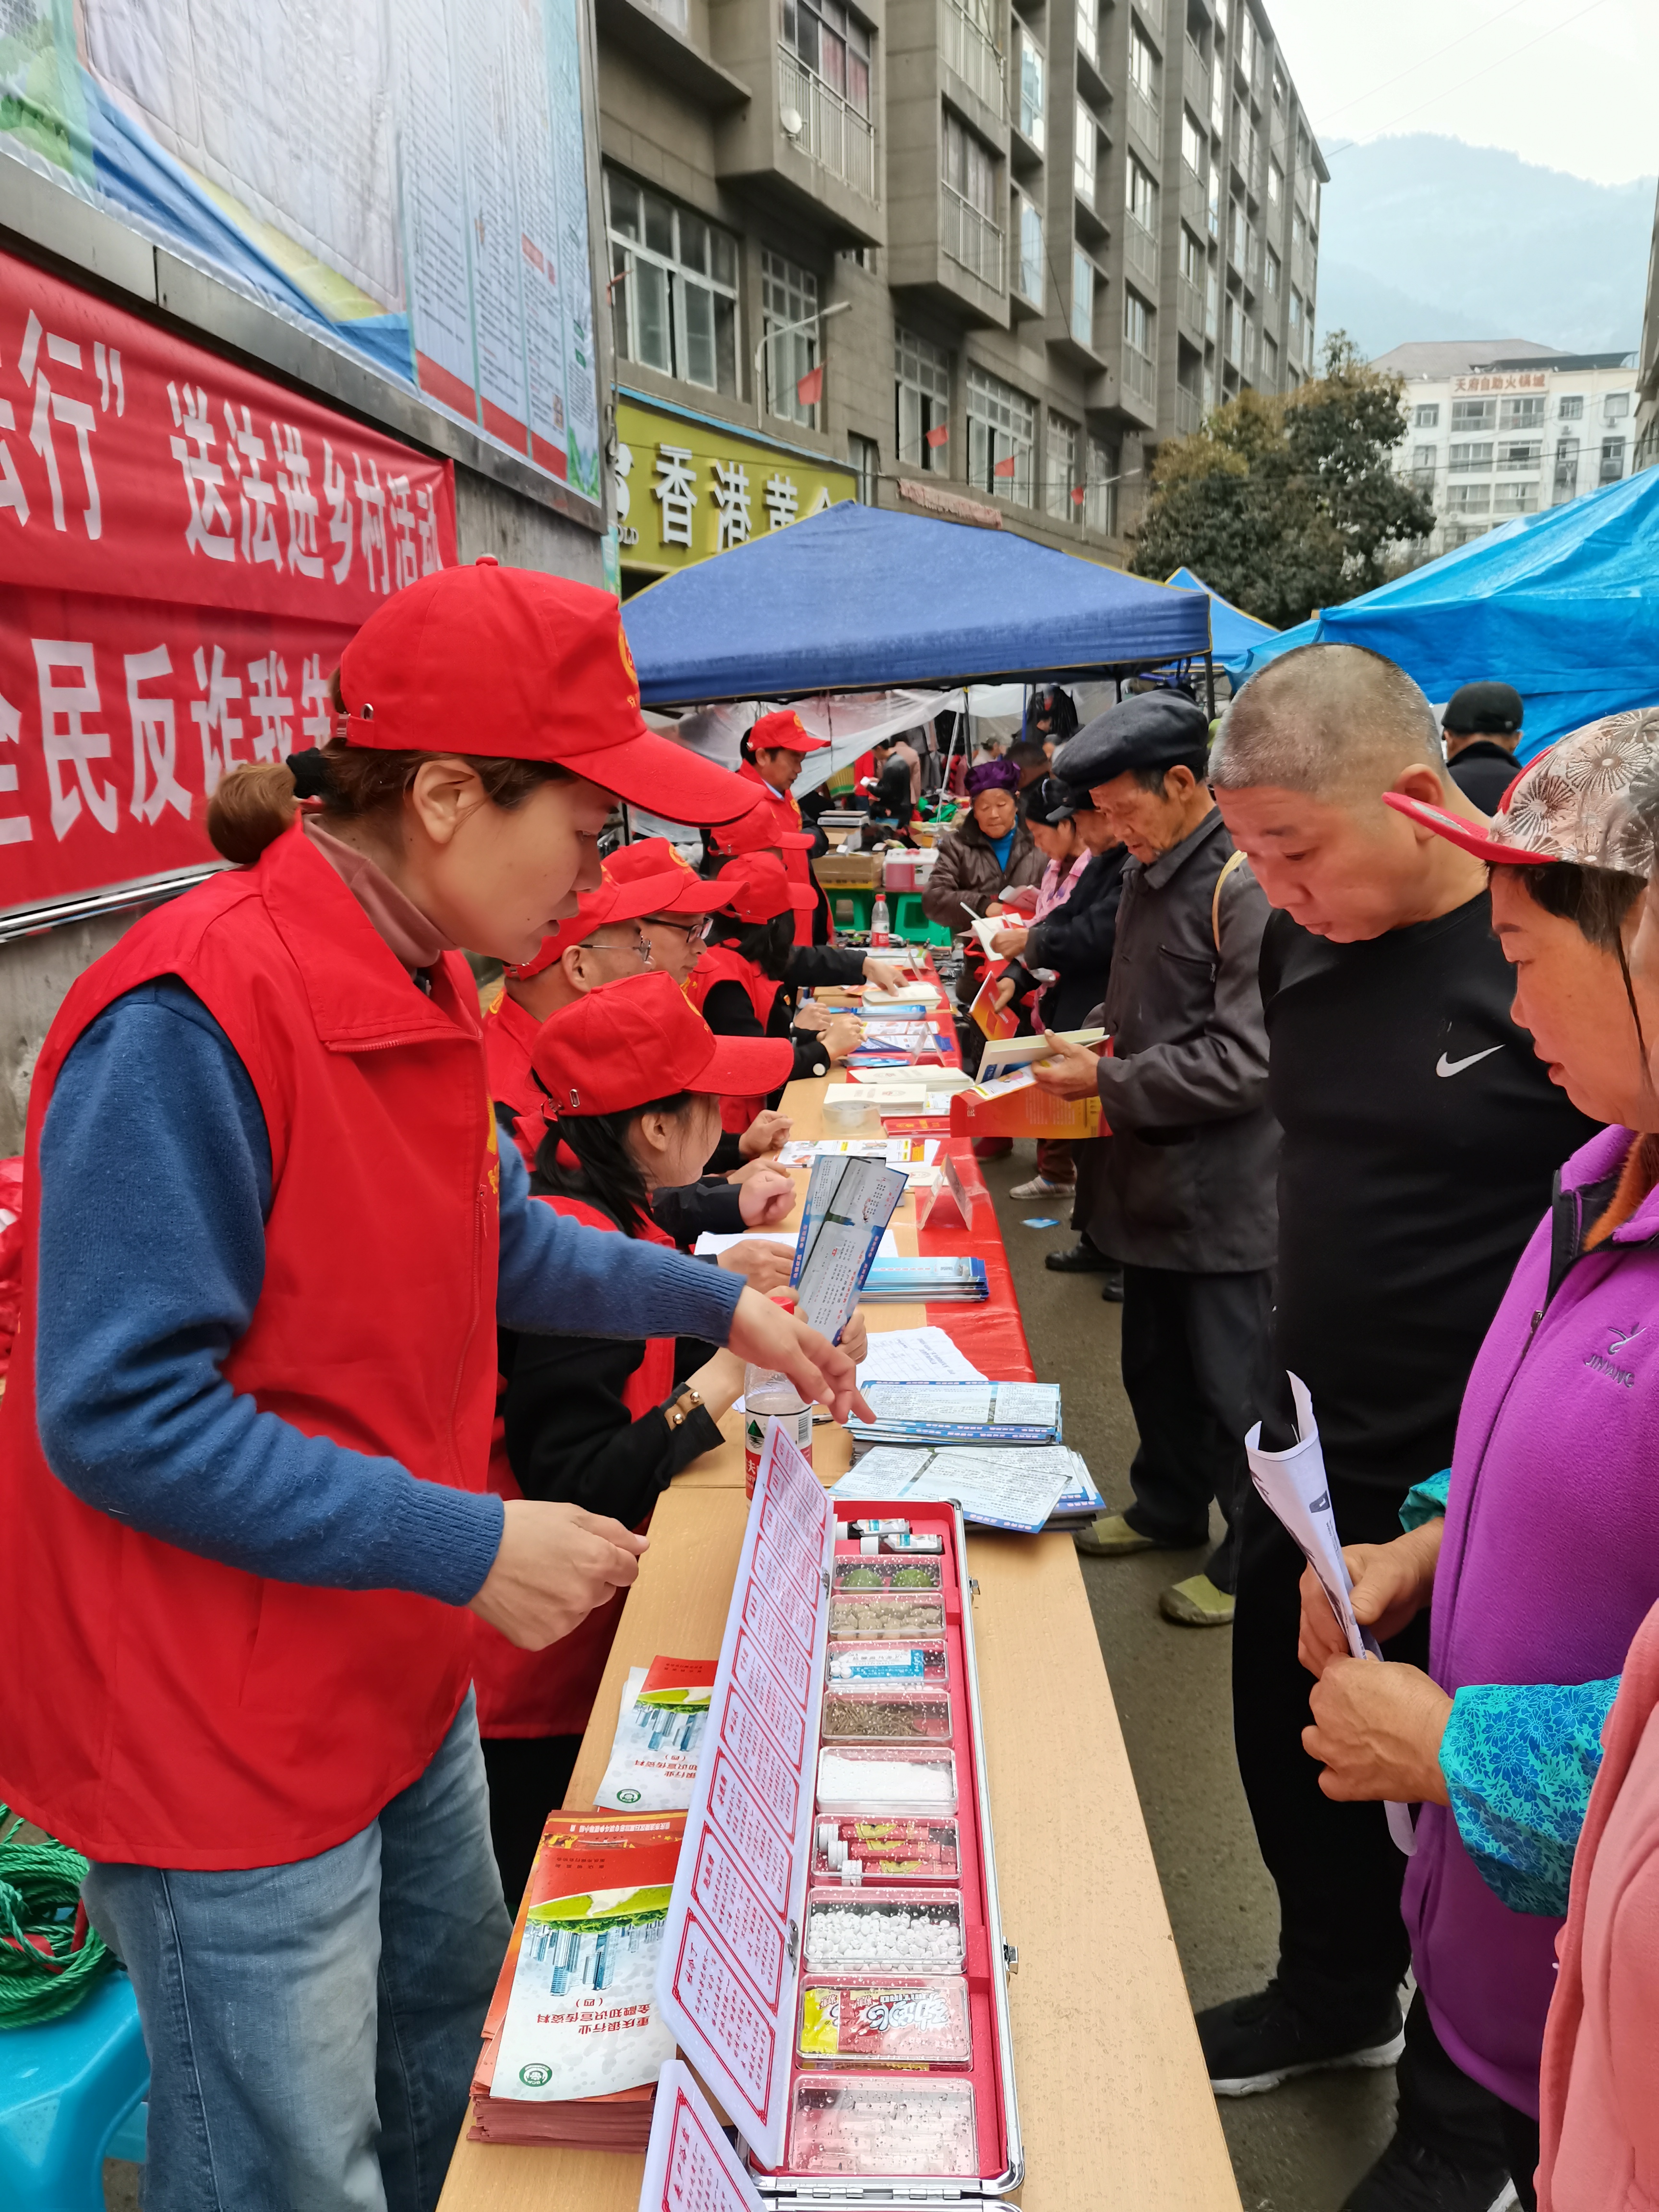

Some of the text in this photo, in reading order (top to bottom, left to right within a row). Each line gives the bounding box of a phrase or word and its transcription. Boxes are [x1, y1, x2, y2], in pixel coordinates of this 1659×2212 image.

[167, 380, 444, 595] 送法进乡村活动
[684, 1940, 698, 1987] 杜冷丁
[536, 2003, 651, 2024] 金融知识宣传资料
[578, 2016, 650, 2035] 重庆银行业
